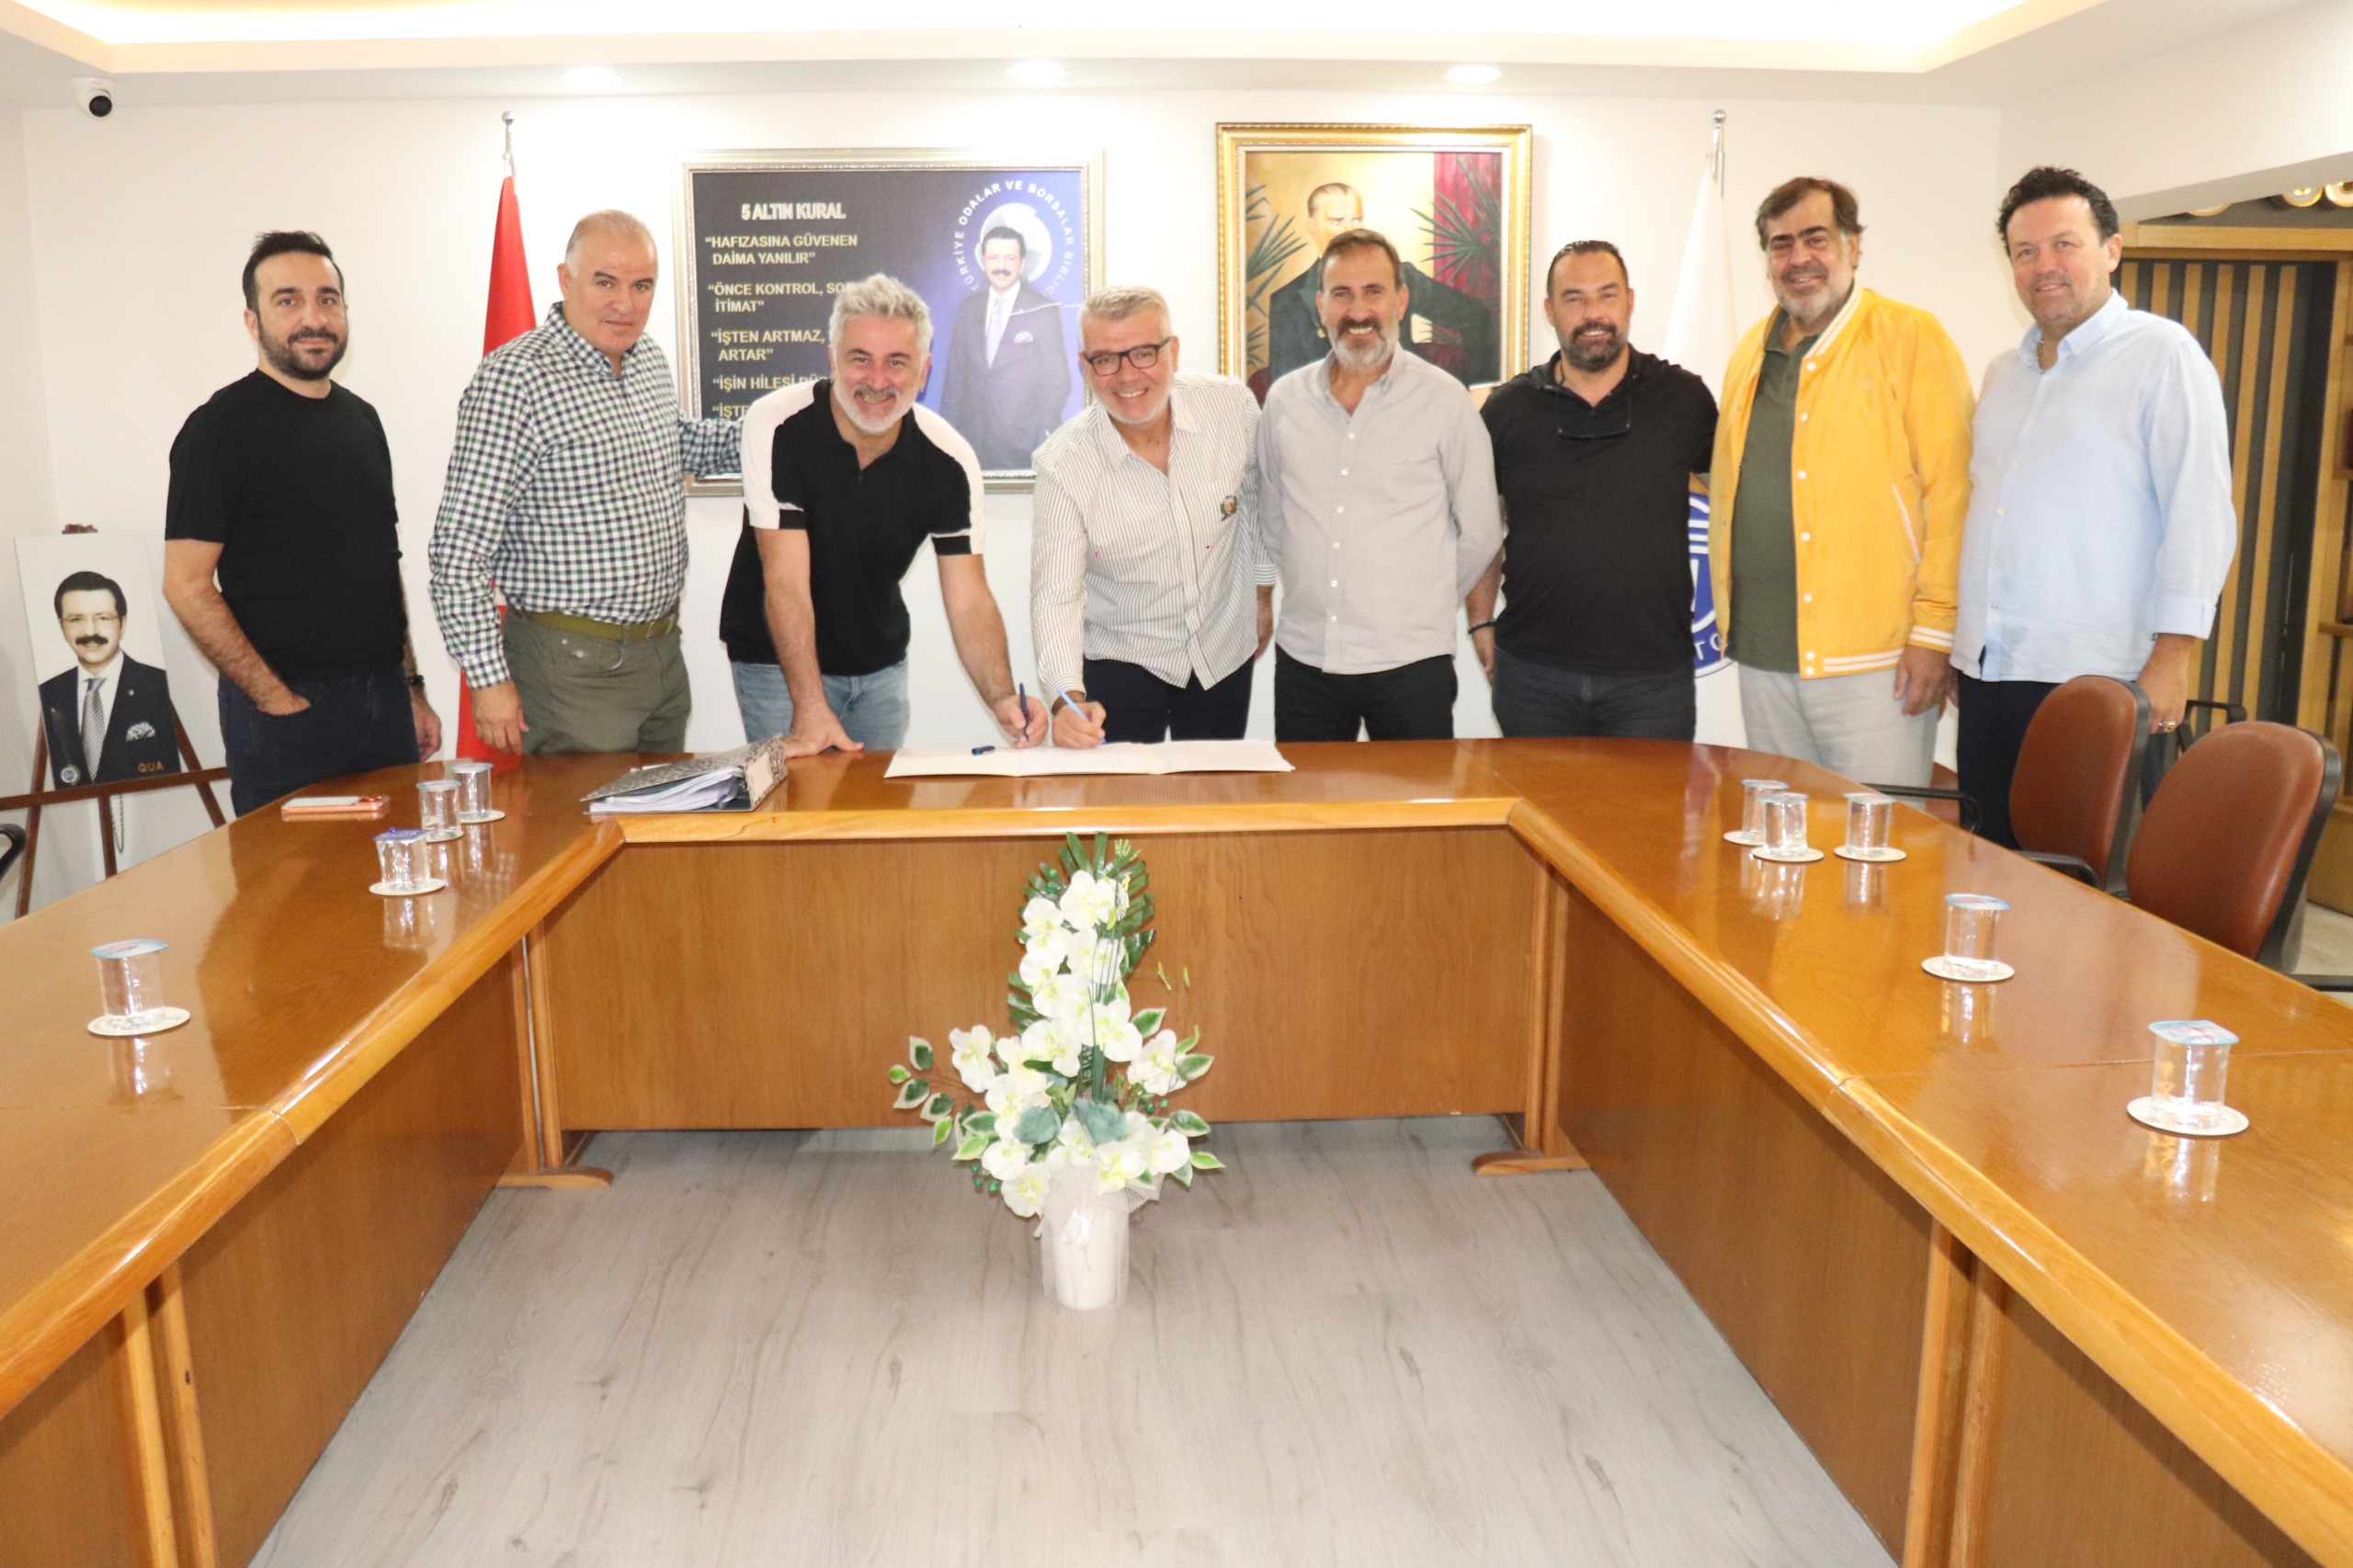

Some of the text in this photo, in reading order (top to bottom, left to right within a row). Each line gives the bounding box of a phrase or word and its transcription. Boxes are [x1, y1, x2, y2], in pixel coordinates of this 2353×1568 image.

[742, 202, 847, 220] 5 ALTIN KURAL
[959, 183, 1001, 225] ODALAR
[1006, 180, 1023, 190] VE
[1028, 183, 1074, 245] BORSALAR
[793, 233, 858, 246] GÜVENEN
[712, 251, 756, 265] DAİMA
[756, 283, 823, 296] KONTROL,
[762, 330, 825, 344] ARTMAZ,
[138, 760, 165, 774] QUA
